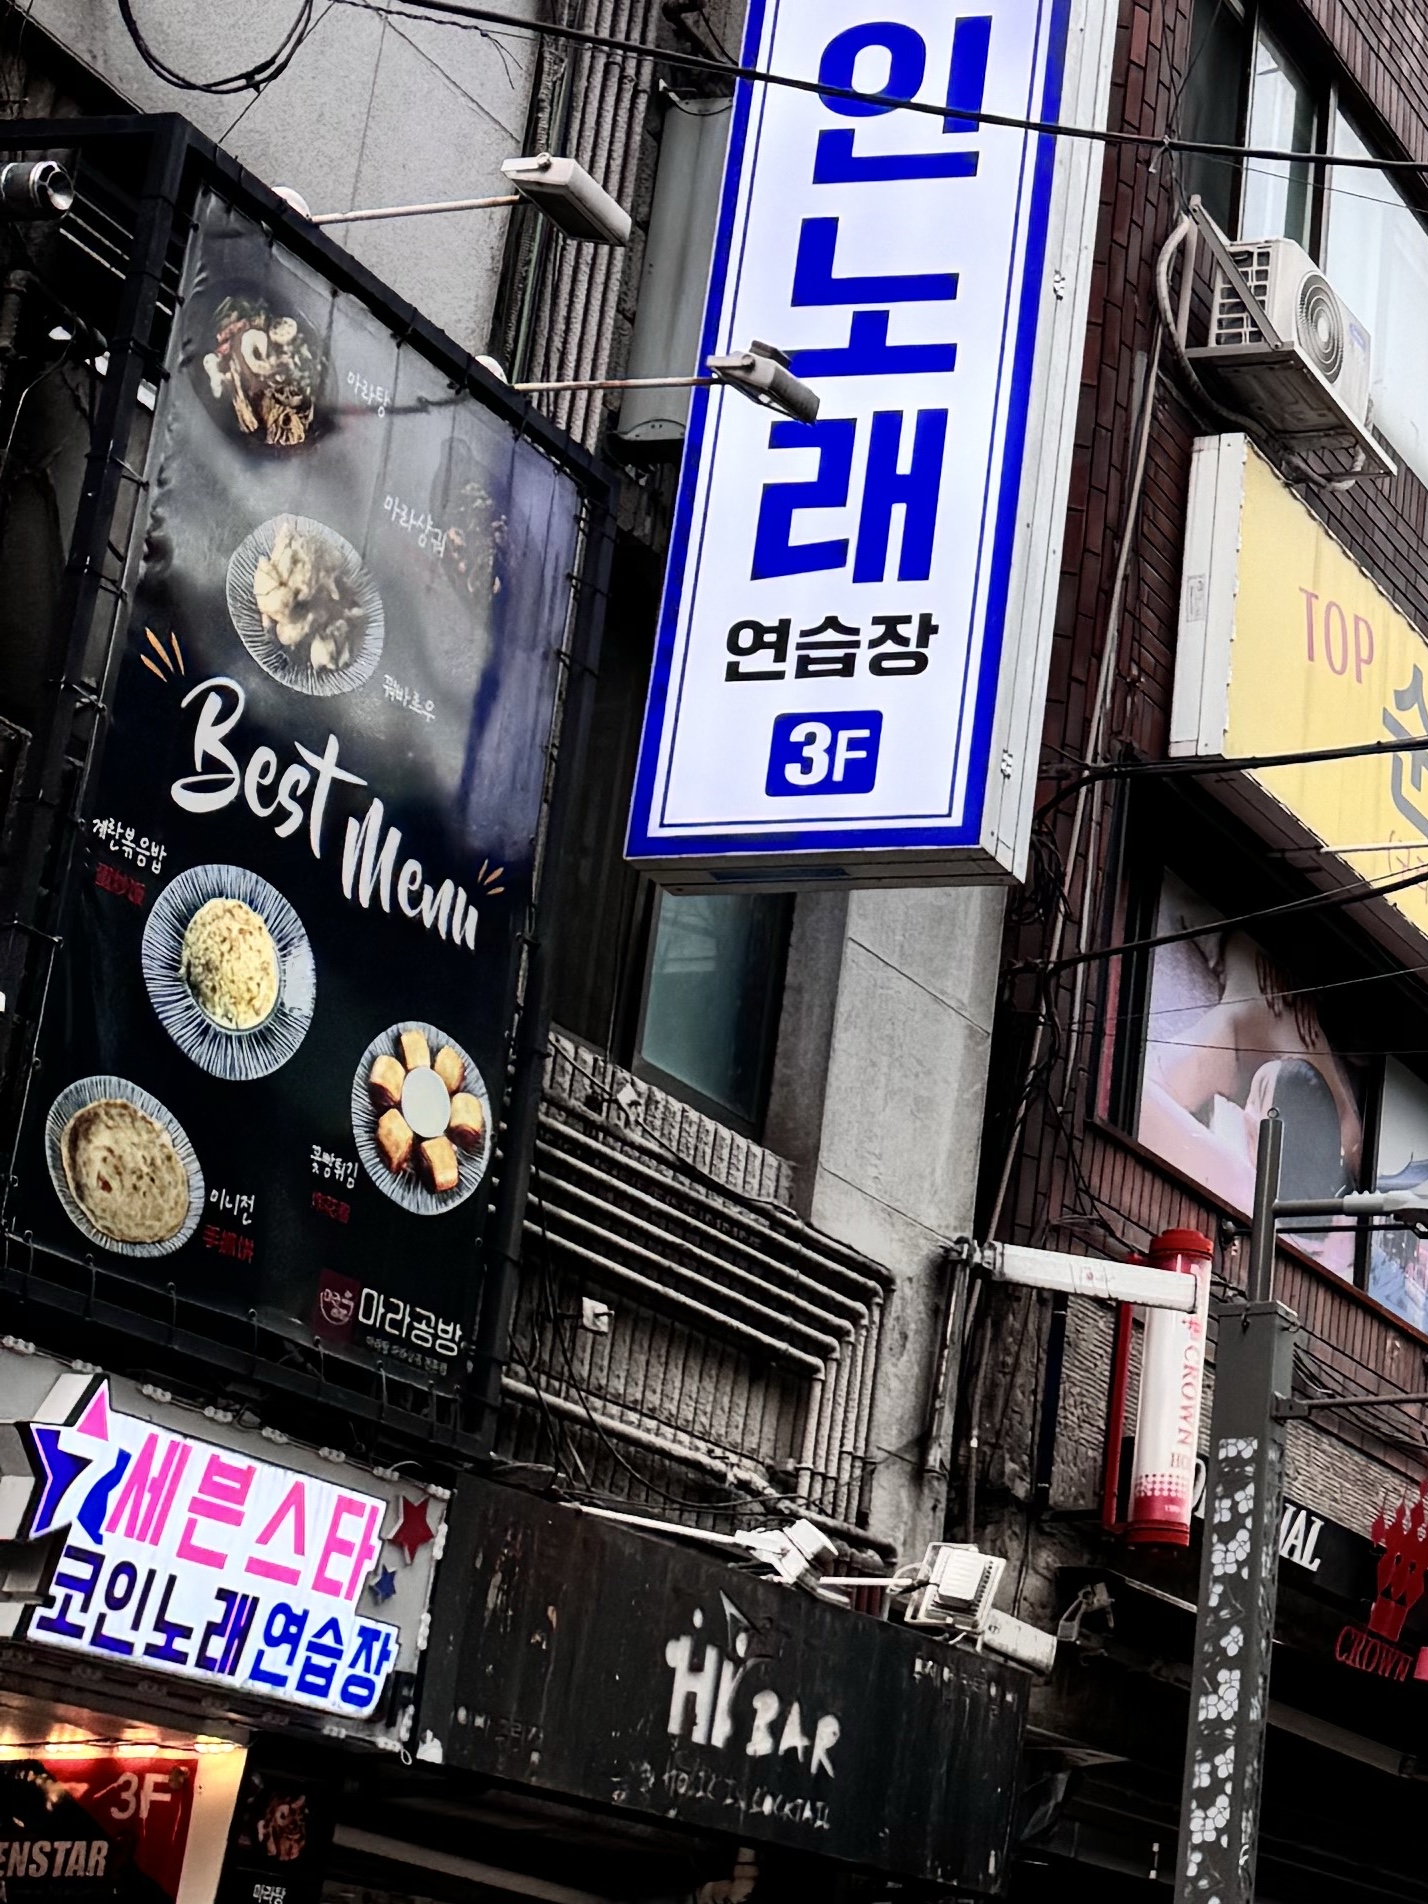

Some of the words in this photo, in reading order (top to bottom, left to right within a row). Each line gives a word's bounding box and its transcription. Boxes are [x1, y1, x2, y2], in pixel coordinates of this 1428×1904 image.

[725, 613, 938, 682] 연습장
[1300, 587, 1375, 684] TOP
[171, 676, 368, 859] Best
[784, 721, 870, 787] 3F
[92, 816, 167, 875] 계란볶음밥
[341, 797, 479, 951] Menu
[209, 1187, 255, 1227] 미니전
[358, 1287, 463, 1357] 마라공방
[1175, 1344, 1199, 1446] CROWN
[105, 1432, 385, 1602] 세븐스타
[36, 1544, 259, 1678] 코인노래
[249, 1600, 399, 1711] 연습장
[1334, 1625, 1414, 1683] CROWN
[110, 1771, 173, 1821] 3F
